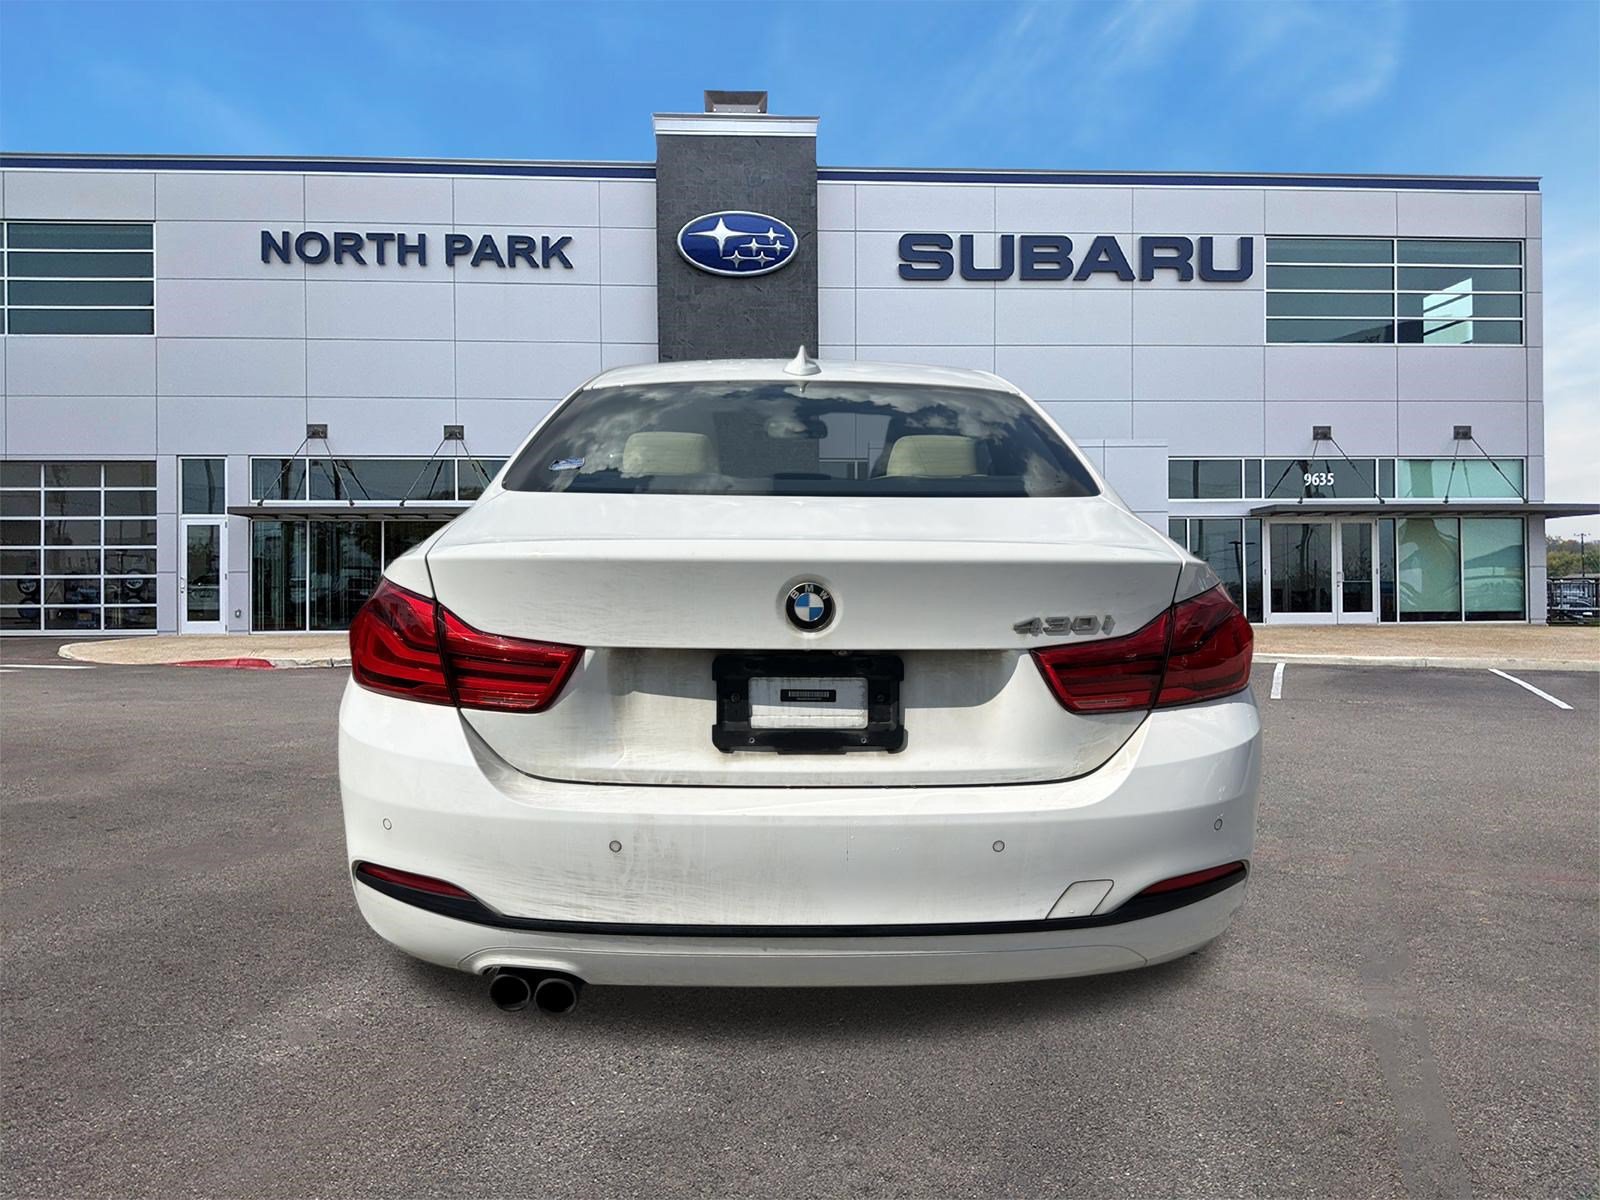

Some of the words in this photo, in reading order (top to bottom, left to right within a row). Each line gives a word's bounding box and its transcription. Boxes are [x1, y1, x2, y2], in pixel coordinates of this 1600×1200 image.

[260, 230, 427, 267] NORTH
[445, 233, 574, 270] PARK
[898, 233, 1254, 282] SUBARU
[1303, 472, 1335, 486] 9635
[790, 584, 830, 600] BMW
[1013, 615, 1116, 637] 430i
